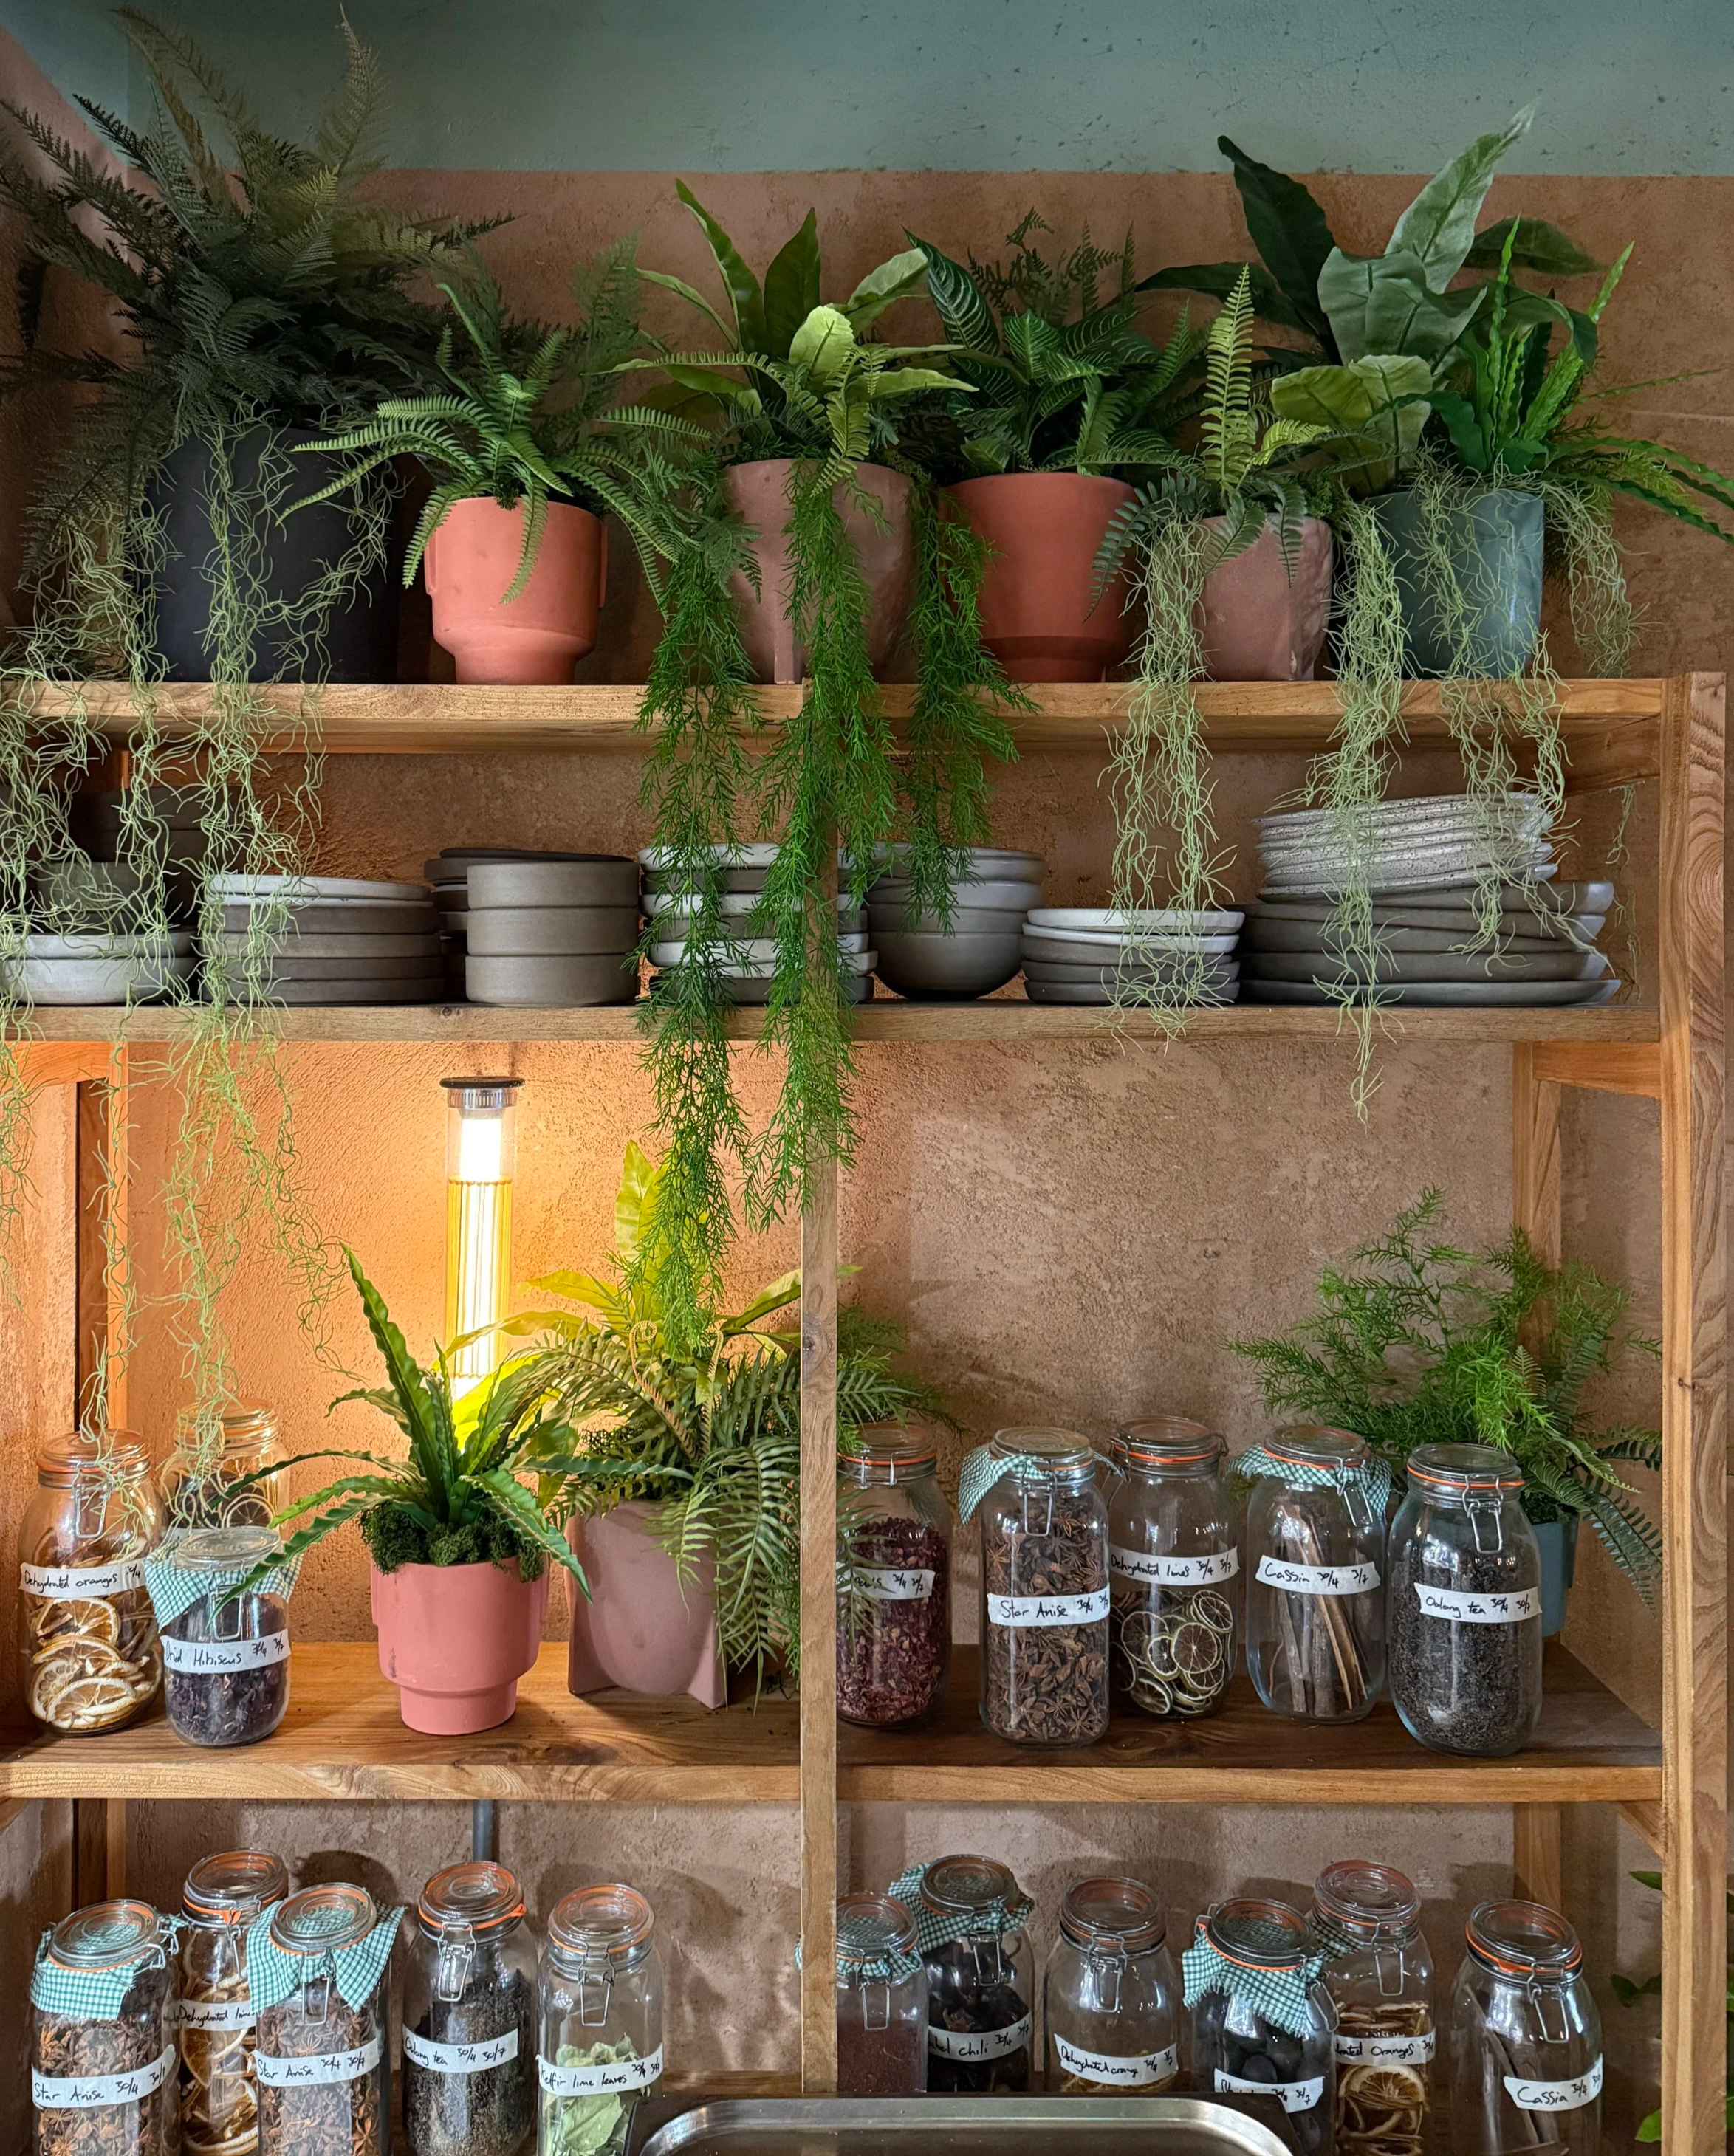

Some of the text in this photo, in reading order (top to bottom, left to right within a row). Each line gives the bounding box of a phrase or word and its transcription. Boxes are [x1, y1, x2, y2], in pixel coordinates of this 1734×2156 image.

[1111, 1554, 1159, 1576] Dehydrated
[1000, 1599, 1029, 1619] Star
[1036, 1601, 1069, 1618] Anise
[1467, 1601, 1487, 1615] tea
[165, 1640, 182, 1664] Dried
[193, 1648, 242, 1667] Hibiscus
[433, 2050, 448, 2066] tea
[456, 2046, 476, 2064] 30/4
[482, 2042, 507, 2063] 30/7
[958, 2039, 989, 2056] chili
[257, 2059, 278, 2079] Star
[285, 2064, 315, 2079] Anise
[35, 2082, 61, 2101] Star
[70, 2084, 105, 2102] Anise
[115, 2077, 139, 2095] 30/4
[572, 2073, 594, 2089] lime
[601, 2072, 627, 2087] leaves
[1517, 2086, 1569, 2106] Cassia
